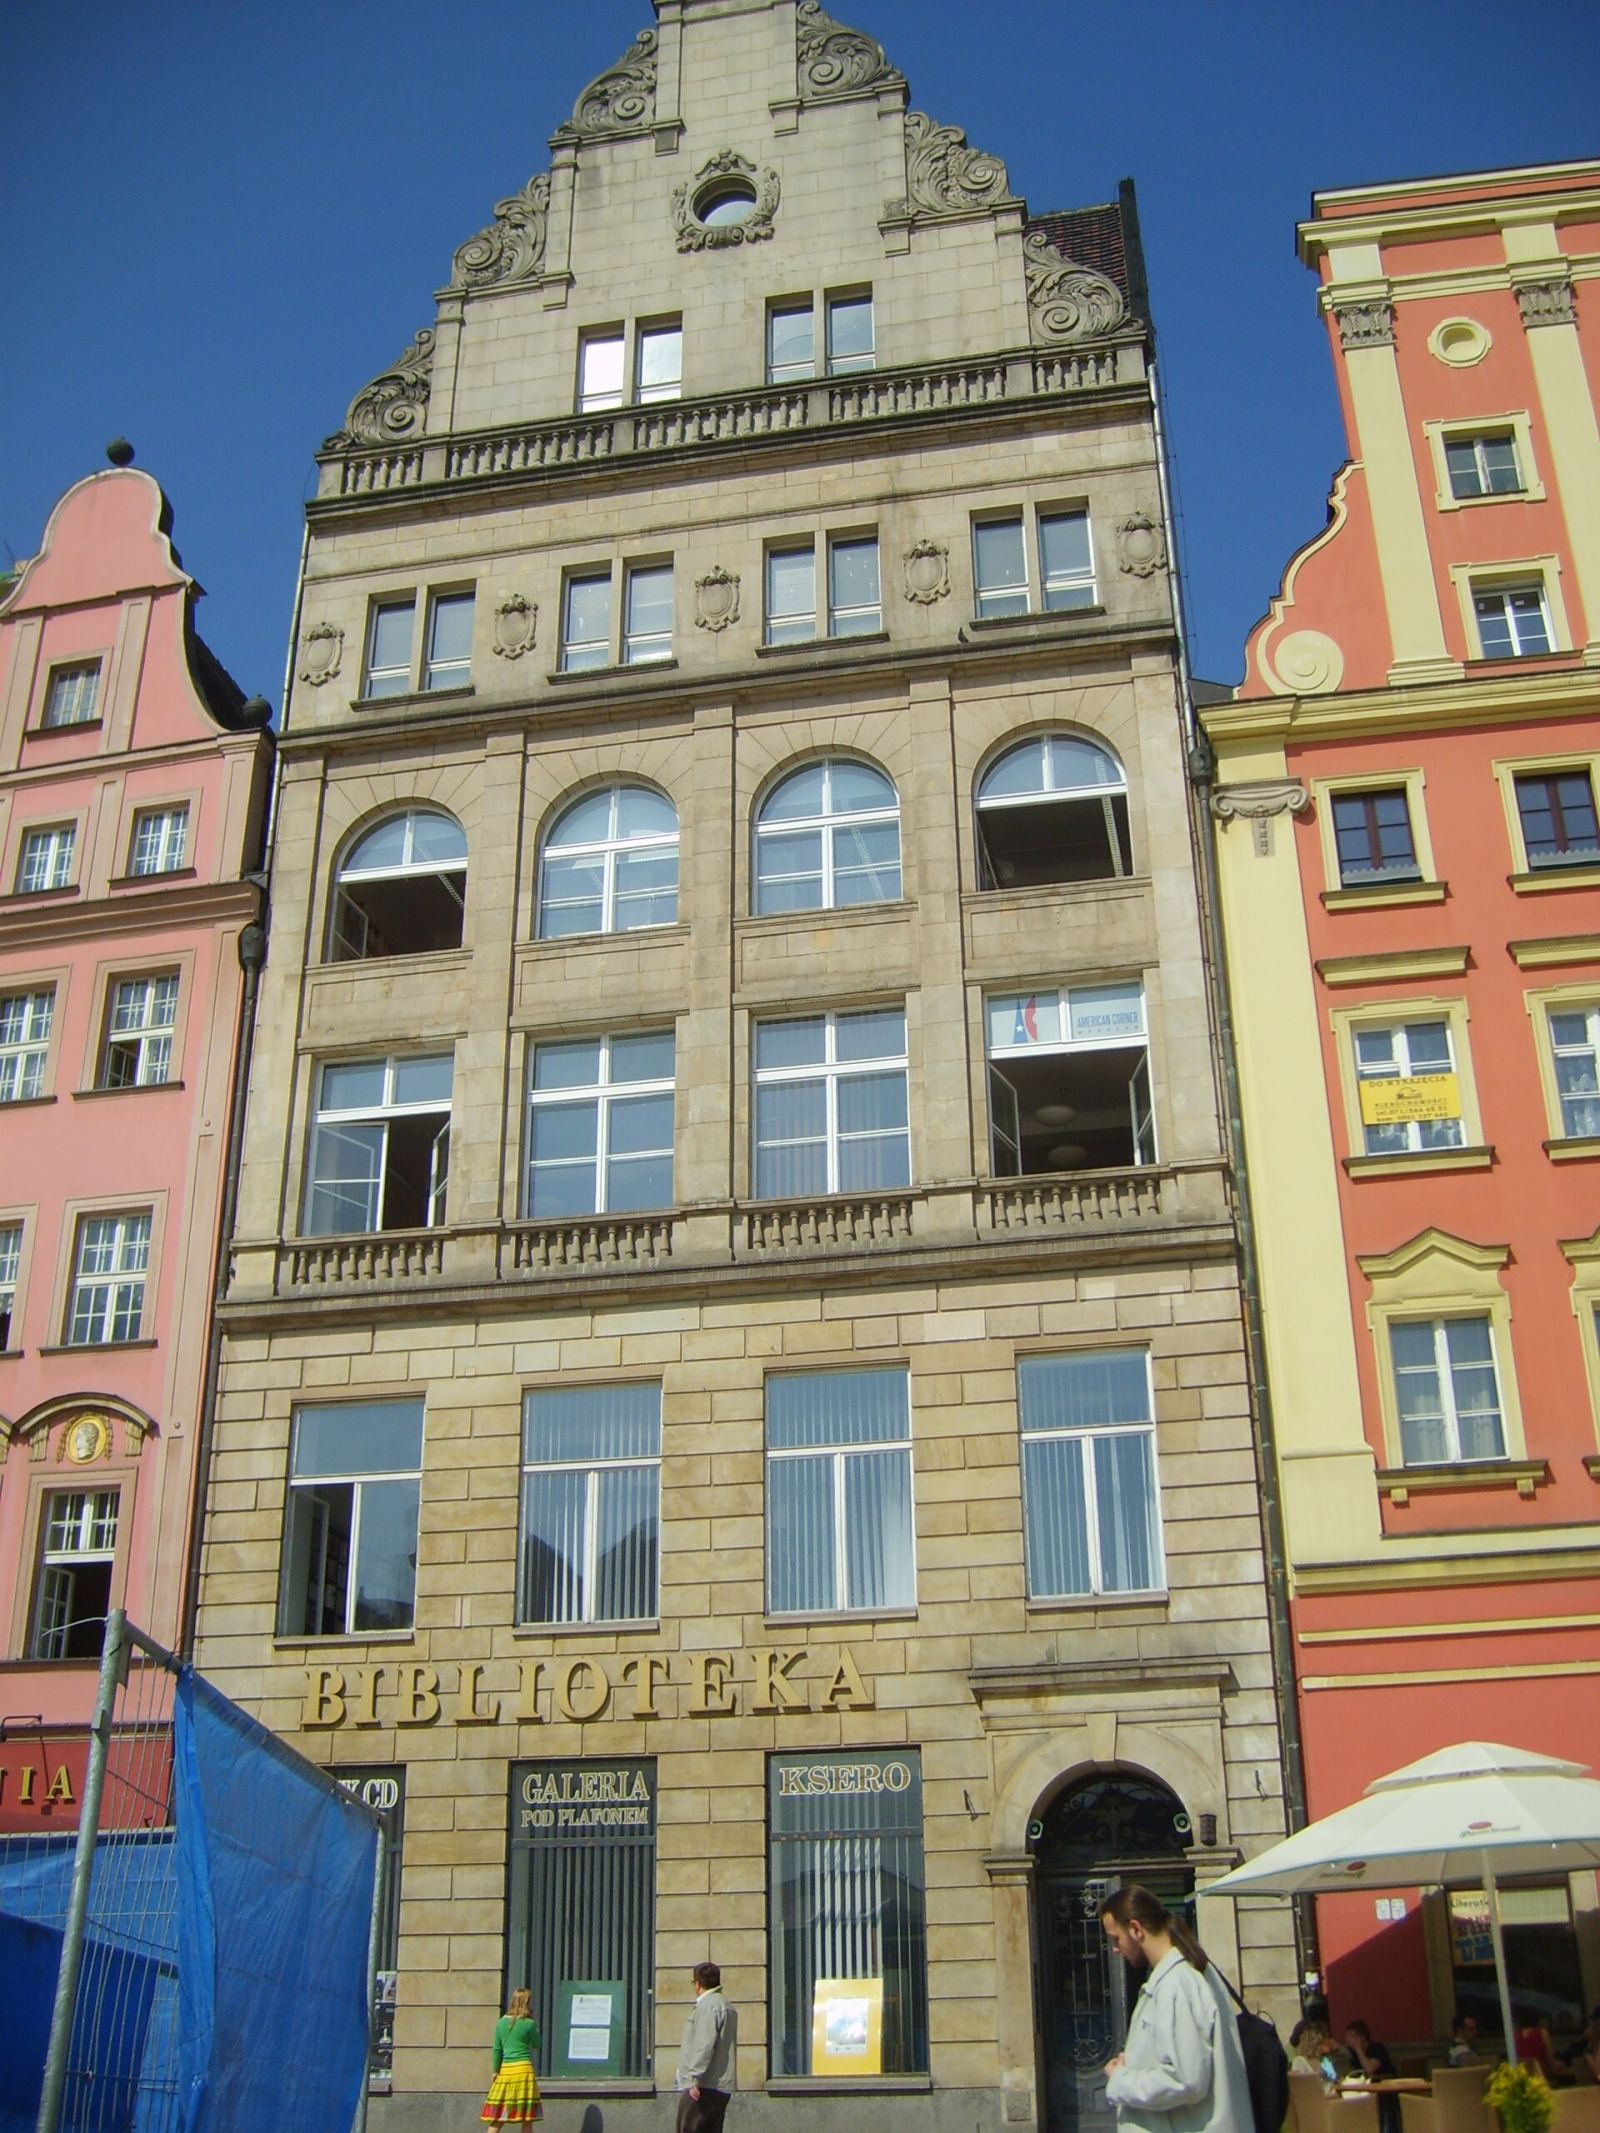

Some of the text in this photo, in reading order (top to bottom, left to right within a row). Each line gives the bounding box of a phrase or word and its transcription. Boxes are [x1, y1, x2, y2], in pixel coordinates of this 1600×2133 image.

[1078, 1011, 1138, 1028] AMERICAN CORNER
[303, 1646, 876, 1731] BIBLIOTEKA
[0, 1764, 74, 1800] IA
[363, 1778, 398, 1808] CD
[522, 1770, 650, 1804] GALERIA
[779, 1762, 911, 1796] KSERO
[521, 1807, 649, 1828] POD PLAFONEM
